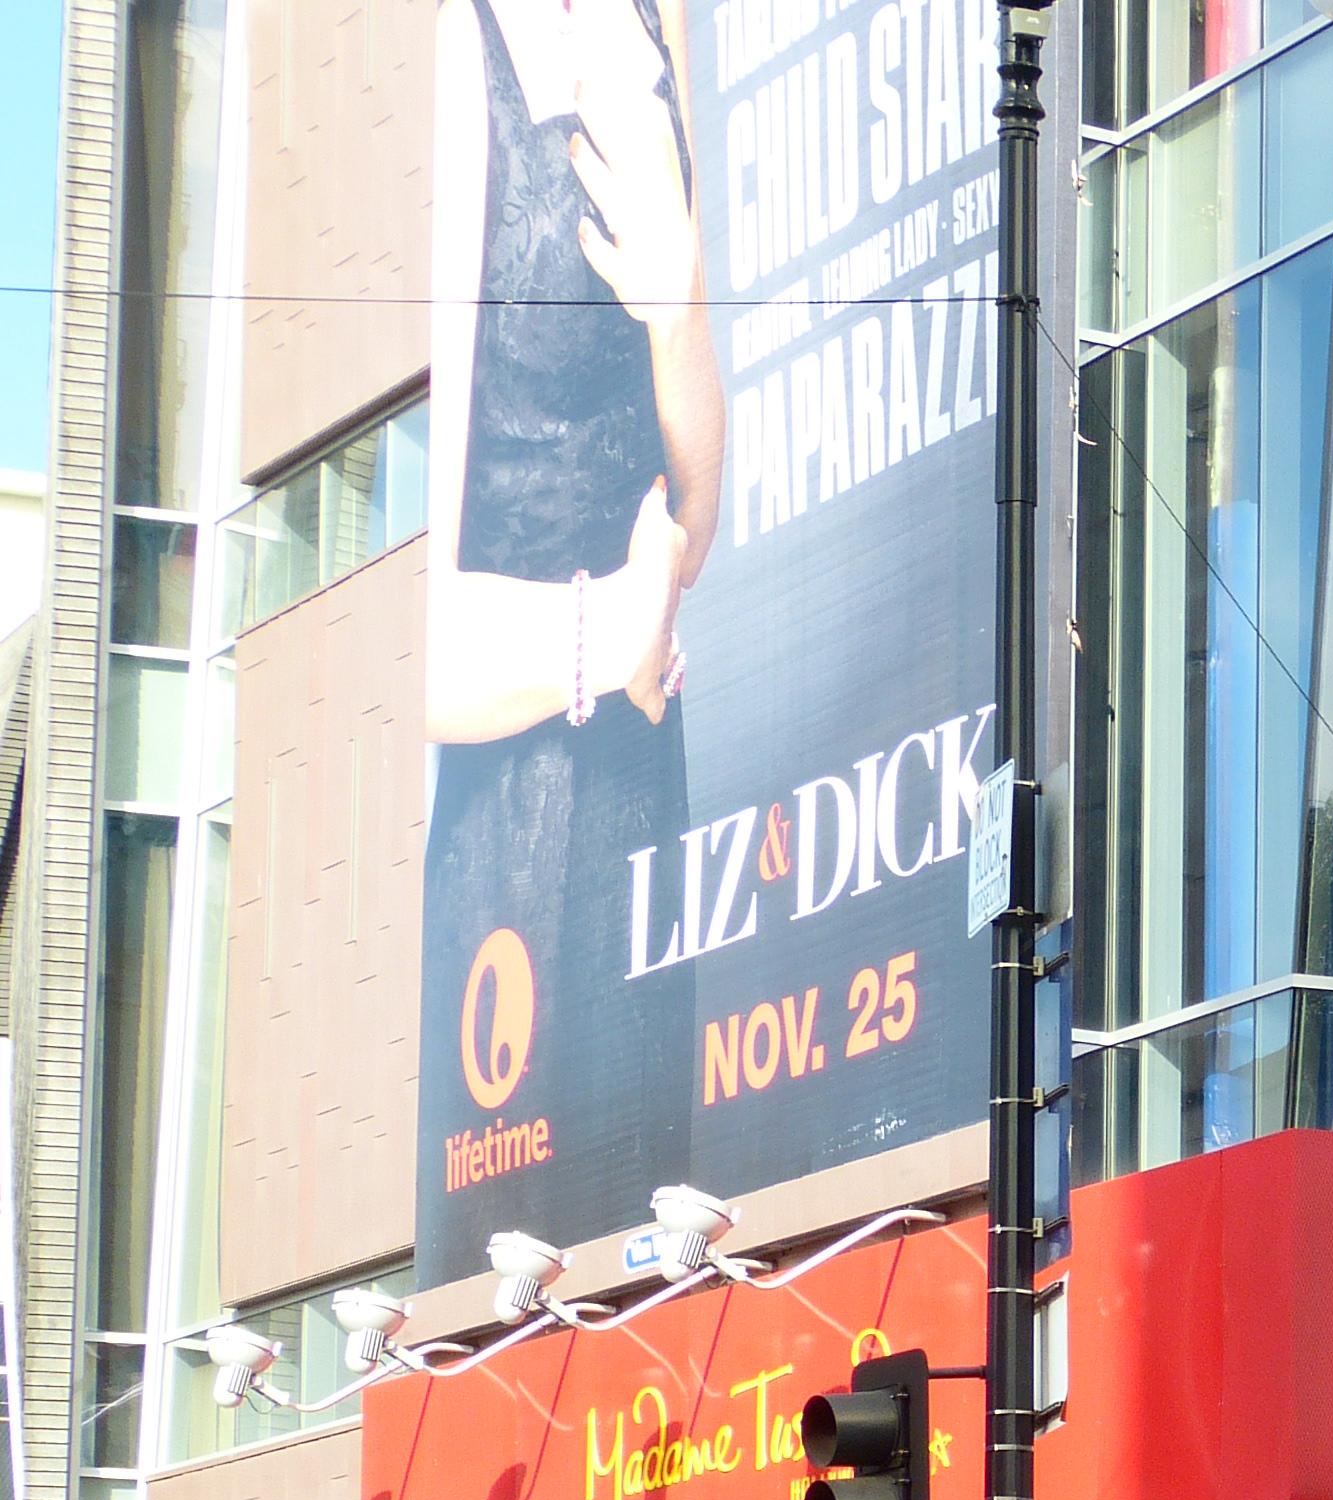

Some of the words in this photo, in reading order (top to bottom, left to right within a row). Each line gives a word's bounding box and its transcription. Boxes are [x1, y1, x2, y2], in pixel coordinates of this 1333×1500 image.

[726, 31, 860, 293] CHILD
[868, 0, 1001, 205] STAR
[893, 199, 939, 279] LADY
[732, 249, 998, 548] PAPARAZZI
[624, 806, 757, 981] LIZ
[757, 802, 791, 881] &
[790, 703, 996, 921] DICK
[702, 986, 824, 1106] NOV.
[844, 950, 918, 1059] 25
[444, 1116, 552, 1193] lifetime
